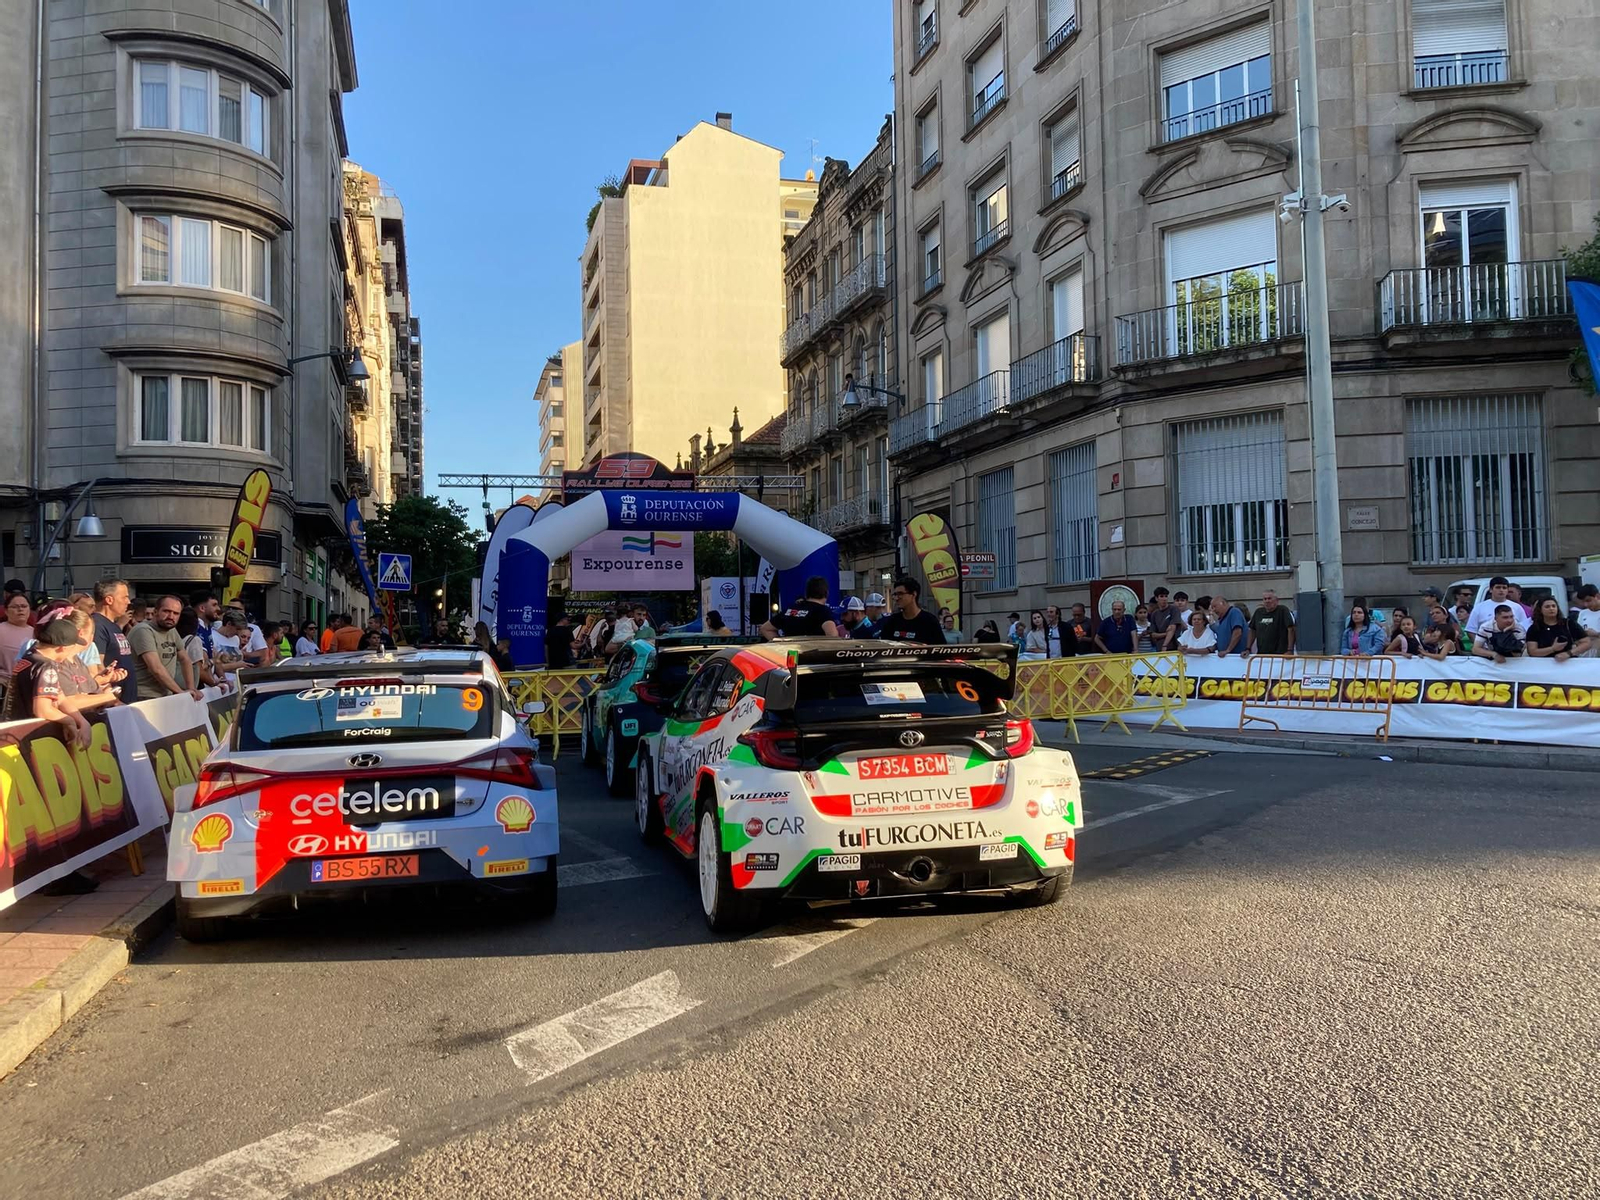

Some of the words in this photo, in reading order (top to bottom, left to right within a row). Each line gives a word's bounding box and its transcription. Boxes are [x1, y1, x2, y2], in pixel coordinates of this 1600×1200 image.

[595, 459, 657, 478] 59
[566, 479, 626, 488] RALLYE
[625, 479, 693, 488] OURENSE
[645, 498, 724, 510] DEPUTACIÓN
[645, 511, 703, 522] OURENSE
[170, 545, 224, 557] SIGLO
[228, 547, 249, 567] GADIS
[583, 558, 684, 572] Expourense
[836, 650, 880, 660] Chony
[881, 648, 895, 656] di
[897, 648, 928, 656] Luca
[931, 646, 981, 656] Finance
[340, 684, 436, 697] HYUNDAI
[730, 680, 743, 709] 6
[956, 681, 980, 702] 6
[1137, 676, 1195, 696] GADIS
[1201, 679, 1267, 699] GADIS
[1346, 680, 1419, 700] GADIS
[1427, 681, 1512, 703] GADIS
[462, 687, 484, 711] 9
[344, 727, 392, 736] ForCraig
[861, 760, 871, 776] S
[873, 758, 910, 776] 7354
[914, 756, 946, 774] BCM
[0, 721, 124, 868] ADIS
[290, 781, 439, 825] cetelem
[730, 791, 790, 800] VALLEROS
[853, 787, 969, 806] CARMOTIVE
[855, 805, 889, 813] PASIÓN
[893, 804, 911, 812] POR
[915, 803, 931, 811] LOS
[935, 801, 969, 809] COCHES
[765, 816, 805, 836] CAR
[335, 830, 437, 852] HYUNDAI
[990, 844, 1016, 853] PAGID
[327, 860, 354, 879] BS
[358, 858, 381, 877] 55
[385, 856, 411, 875] RX
[487, 861, 526, 874] PIRELLI
[829, 855, 860, 865] PAGID
[201, 882, 241, 893] PIRELLI
